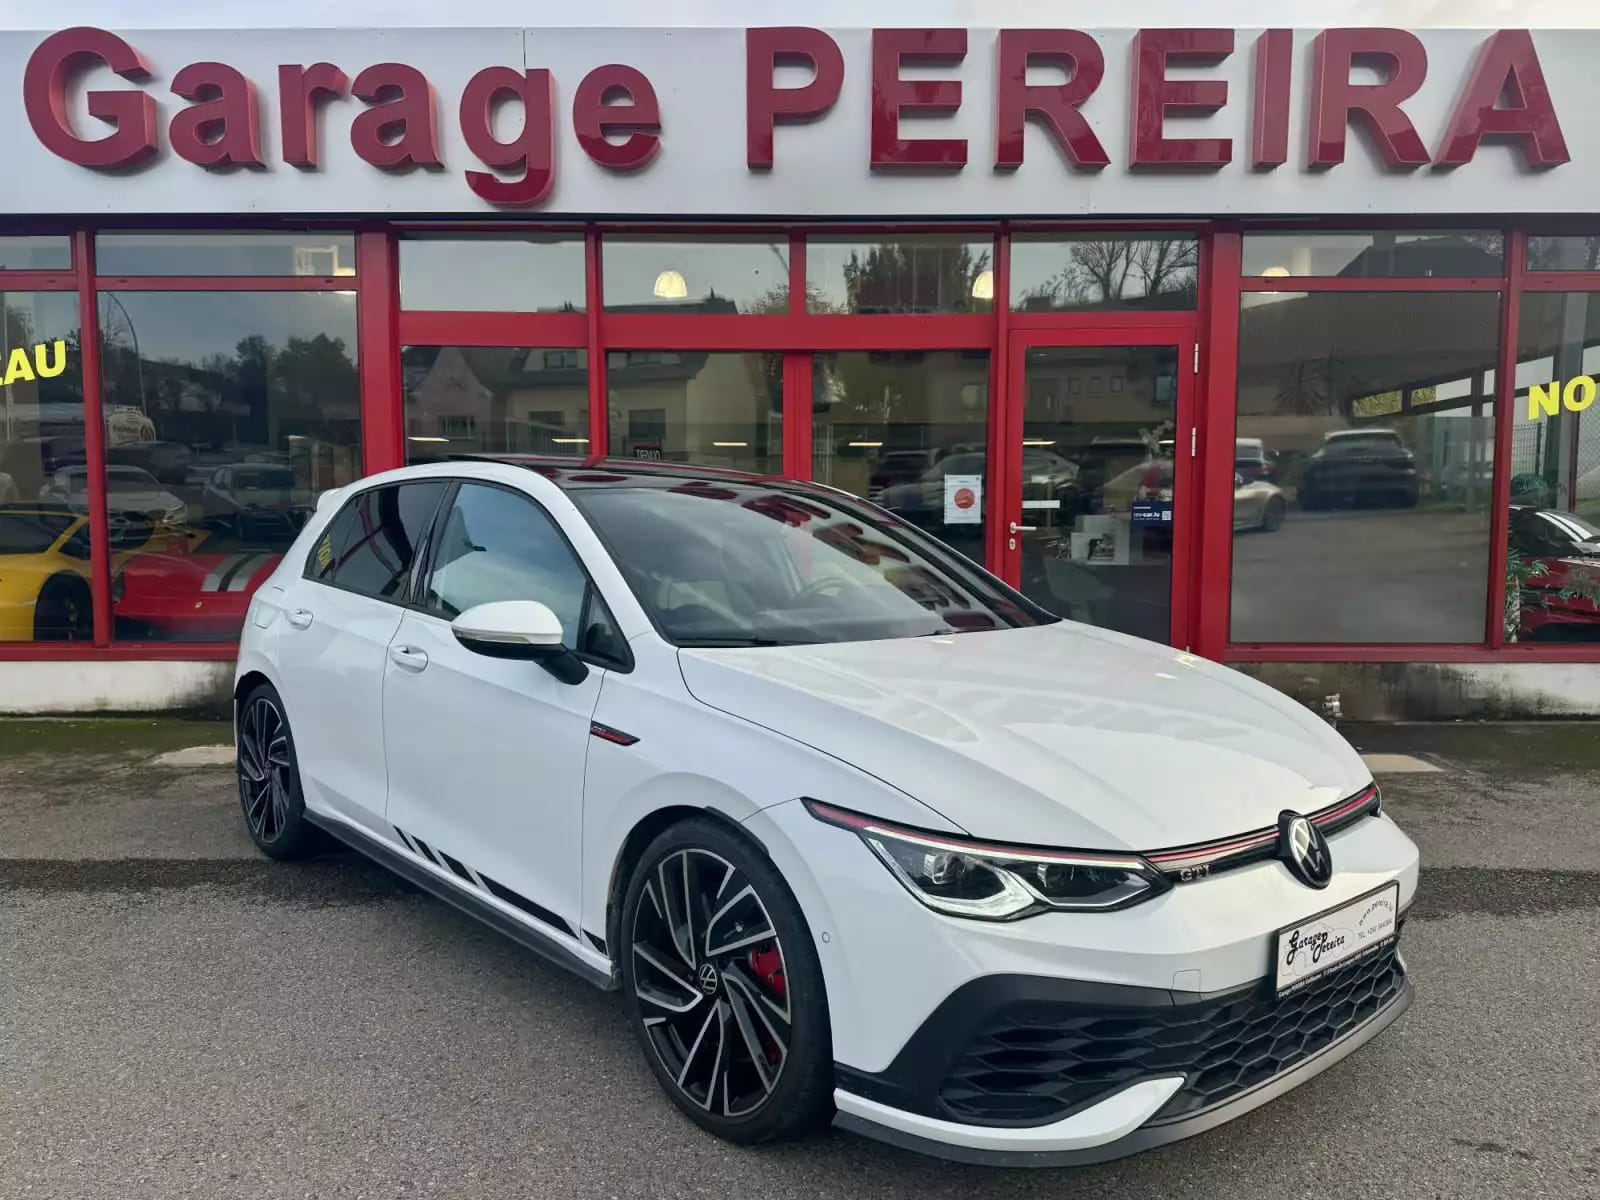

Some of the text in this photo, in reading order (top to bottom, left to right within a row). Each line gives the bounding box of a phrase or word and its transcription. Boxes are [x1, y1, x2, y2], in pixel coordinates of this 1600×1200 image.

[23, 26, 1570, 207] Garage PEREIRA
[0, 340, 66, 386] AU
[1528, 375, 1597, 420] NO
[1286, 930, 1321, 966] Garage
